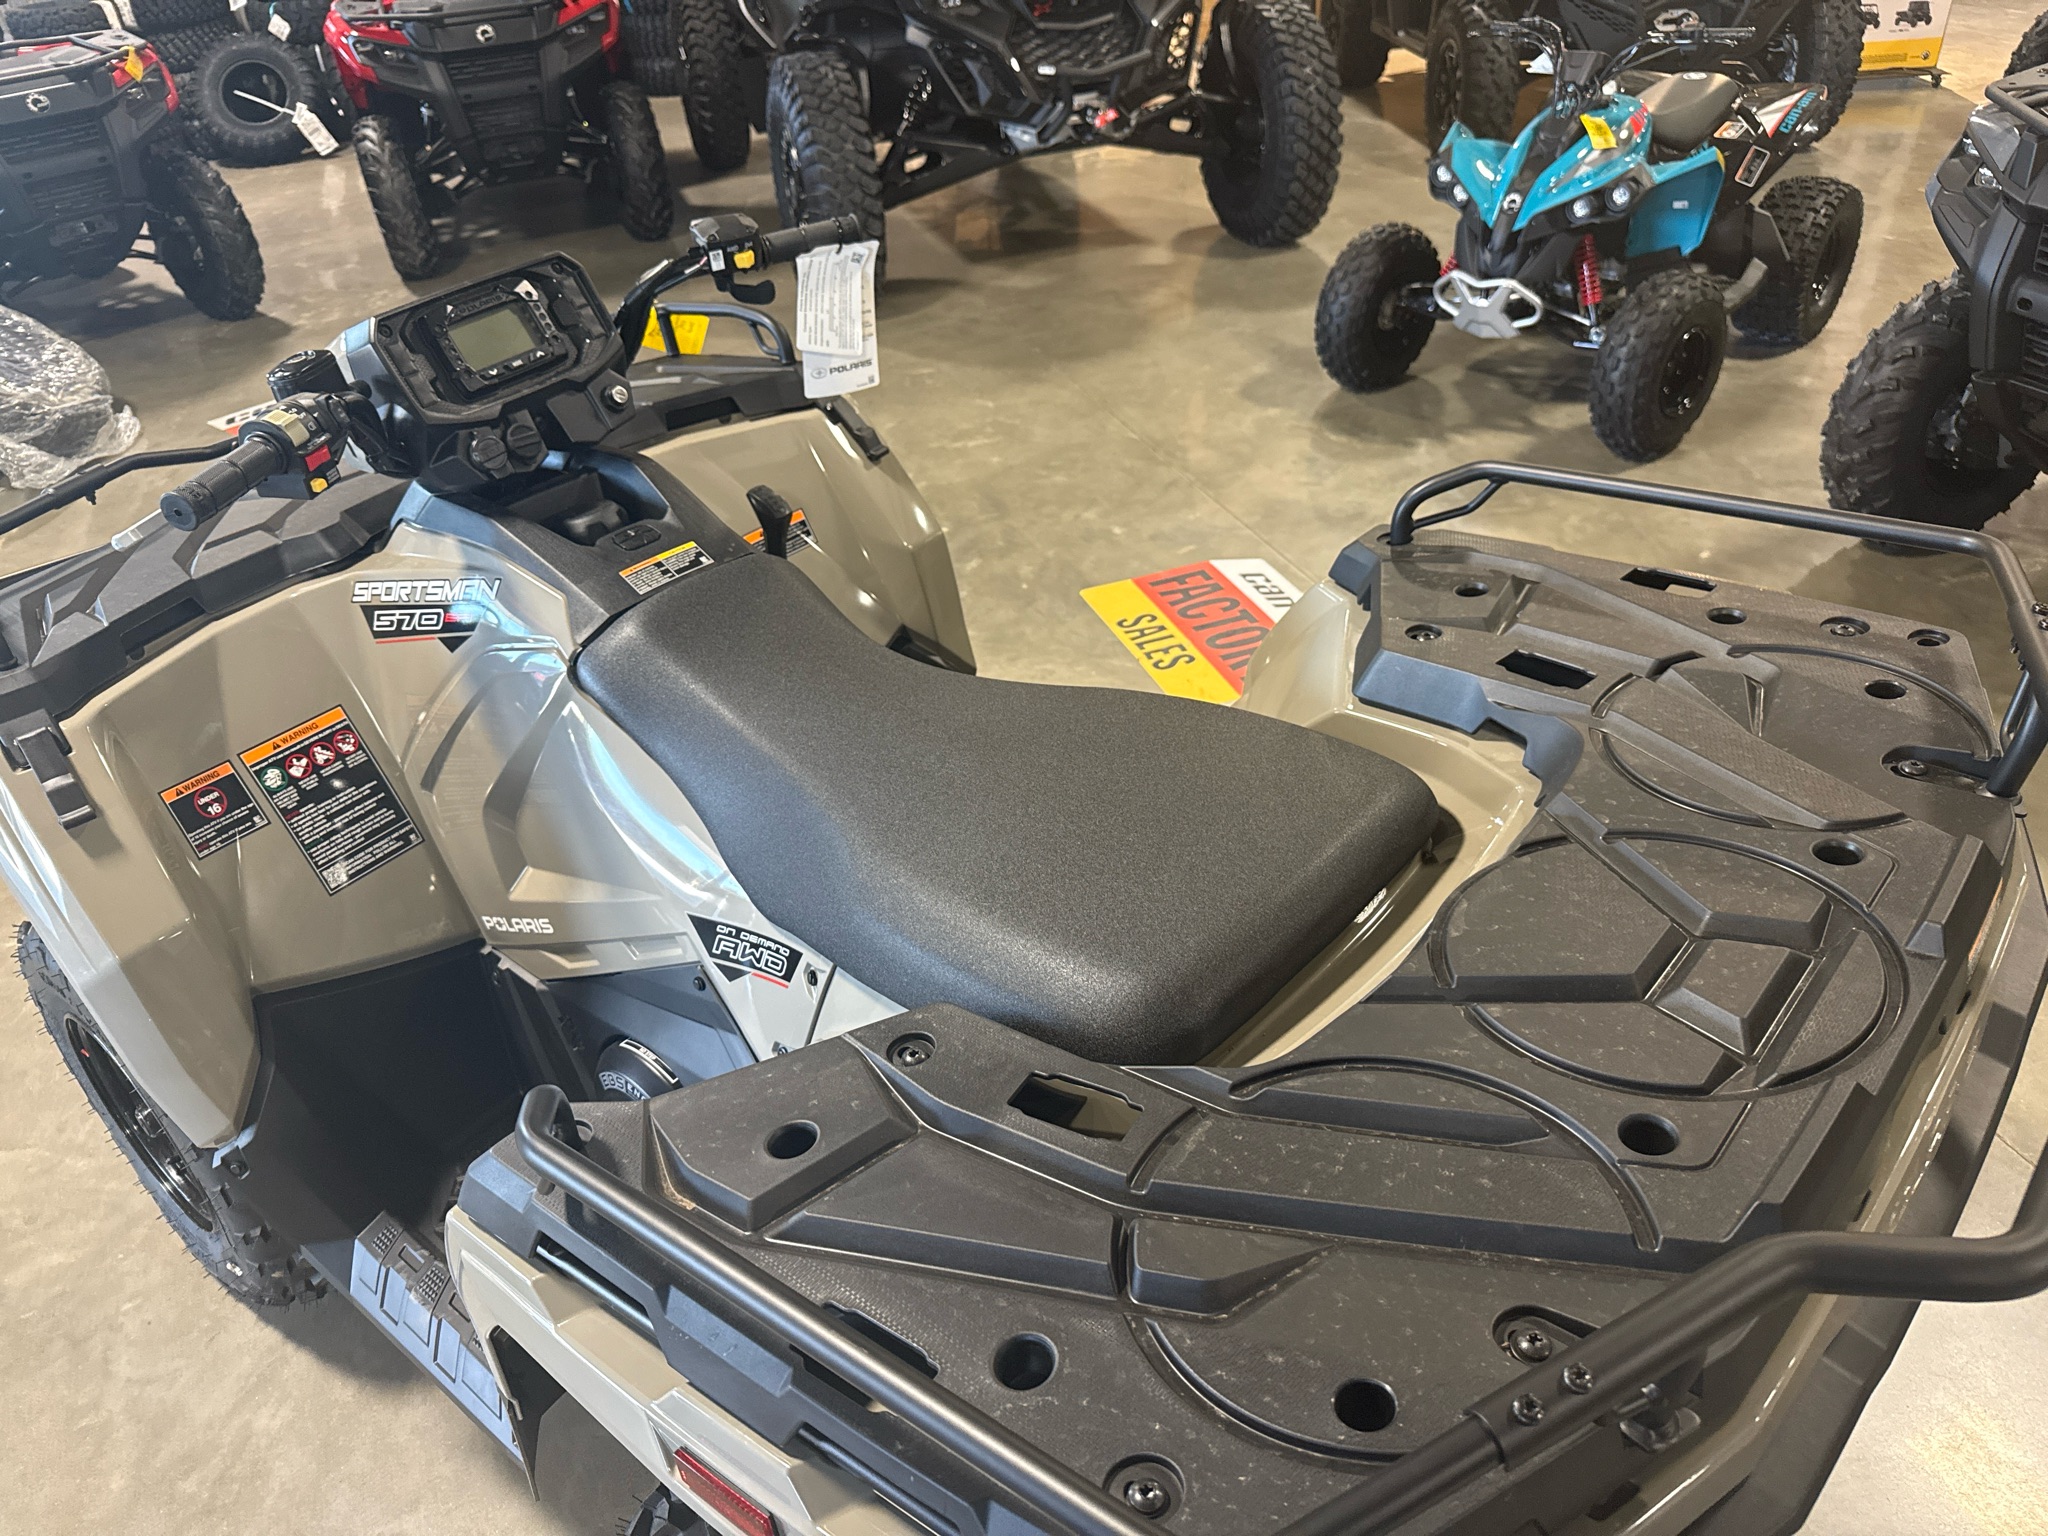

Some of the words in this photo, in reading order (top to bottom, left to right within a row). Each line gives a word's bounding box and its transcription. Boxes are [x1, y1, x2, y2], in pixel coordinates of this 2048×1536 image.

[829, 359, 872, 375] POLARIS
[351, 578, 502, 602] SPORTSMAN
[373, 608, 445, 631] 570
[1148, 569, 1271, 681] FACTO
[1116, 613, 1196, 671] SALES
[279, 721, 319, 745] WARNING
[181, 769, 220, 792] WARNING
[196, 790, 220, 806] UNDER
[205, 801, 223, 816] 16
[481, 915, 554, 934] POLARIS
[716, 924, 736, 936] ON
[740, 931, 790, 957] DEMAND
[712, 934, 787, 977] AWD
[601, 1074, 624, 1090] EBS
